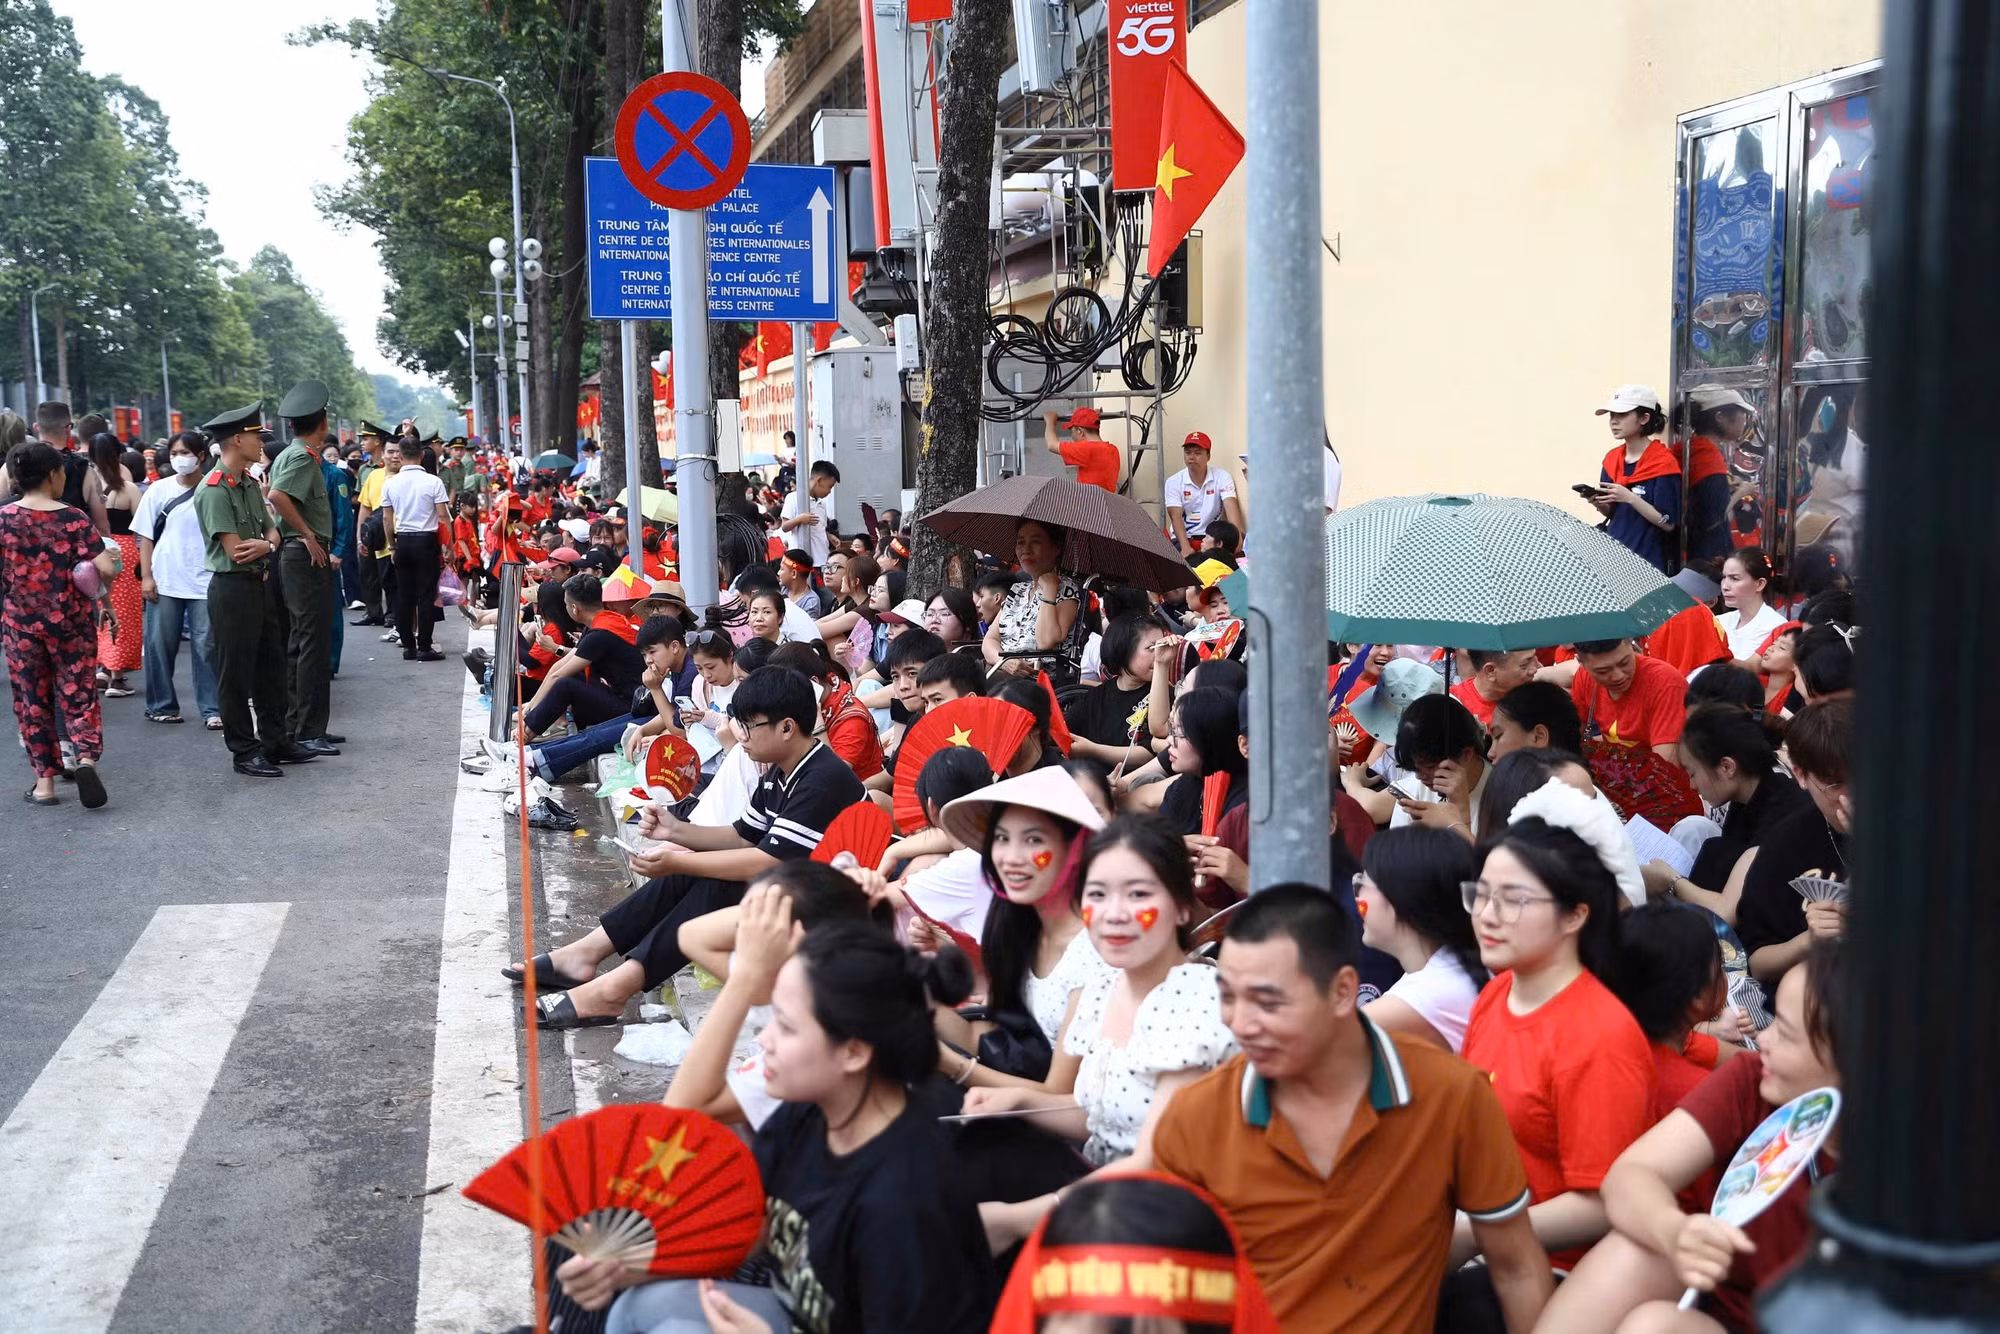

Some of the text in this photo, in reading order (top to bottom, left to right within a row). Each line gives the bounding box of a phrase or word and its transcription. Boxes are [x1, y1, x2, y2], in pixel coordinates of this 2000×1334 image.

[1126, 1, 1174, 13] viettel
[1116, 16, 1175, 56] 5G
[722, 202, 759, 213] PALACE
[598, 219, 640, 231] TRUNG
[706, 223, 726, 235] GHỊ
[730, 219, 763, 234] QUỐC
[768, 220, 784, 234] TẾ
[598, 235, 637, 245] CENTRE
[641, 236, 654, 246] DE
[728, 238, 810, 249] INTERNATIONALES
[599, 249, 669, 260] INTERNATIONA
[744, 252, 781, 263] CENTRE
[620, 268, 801, 283] TRUNG ÁO CHÍ QUỐC TẾ
[621, 285, 659, 295] CENTRE
[721, 286, 800, 297] INTERNATIONALE
[622, 299, 774, 311] INTERNATI RESS CENTRE
